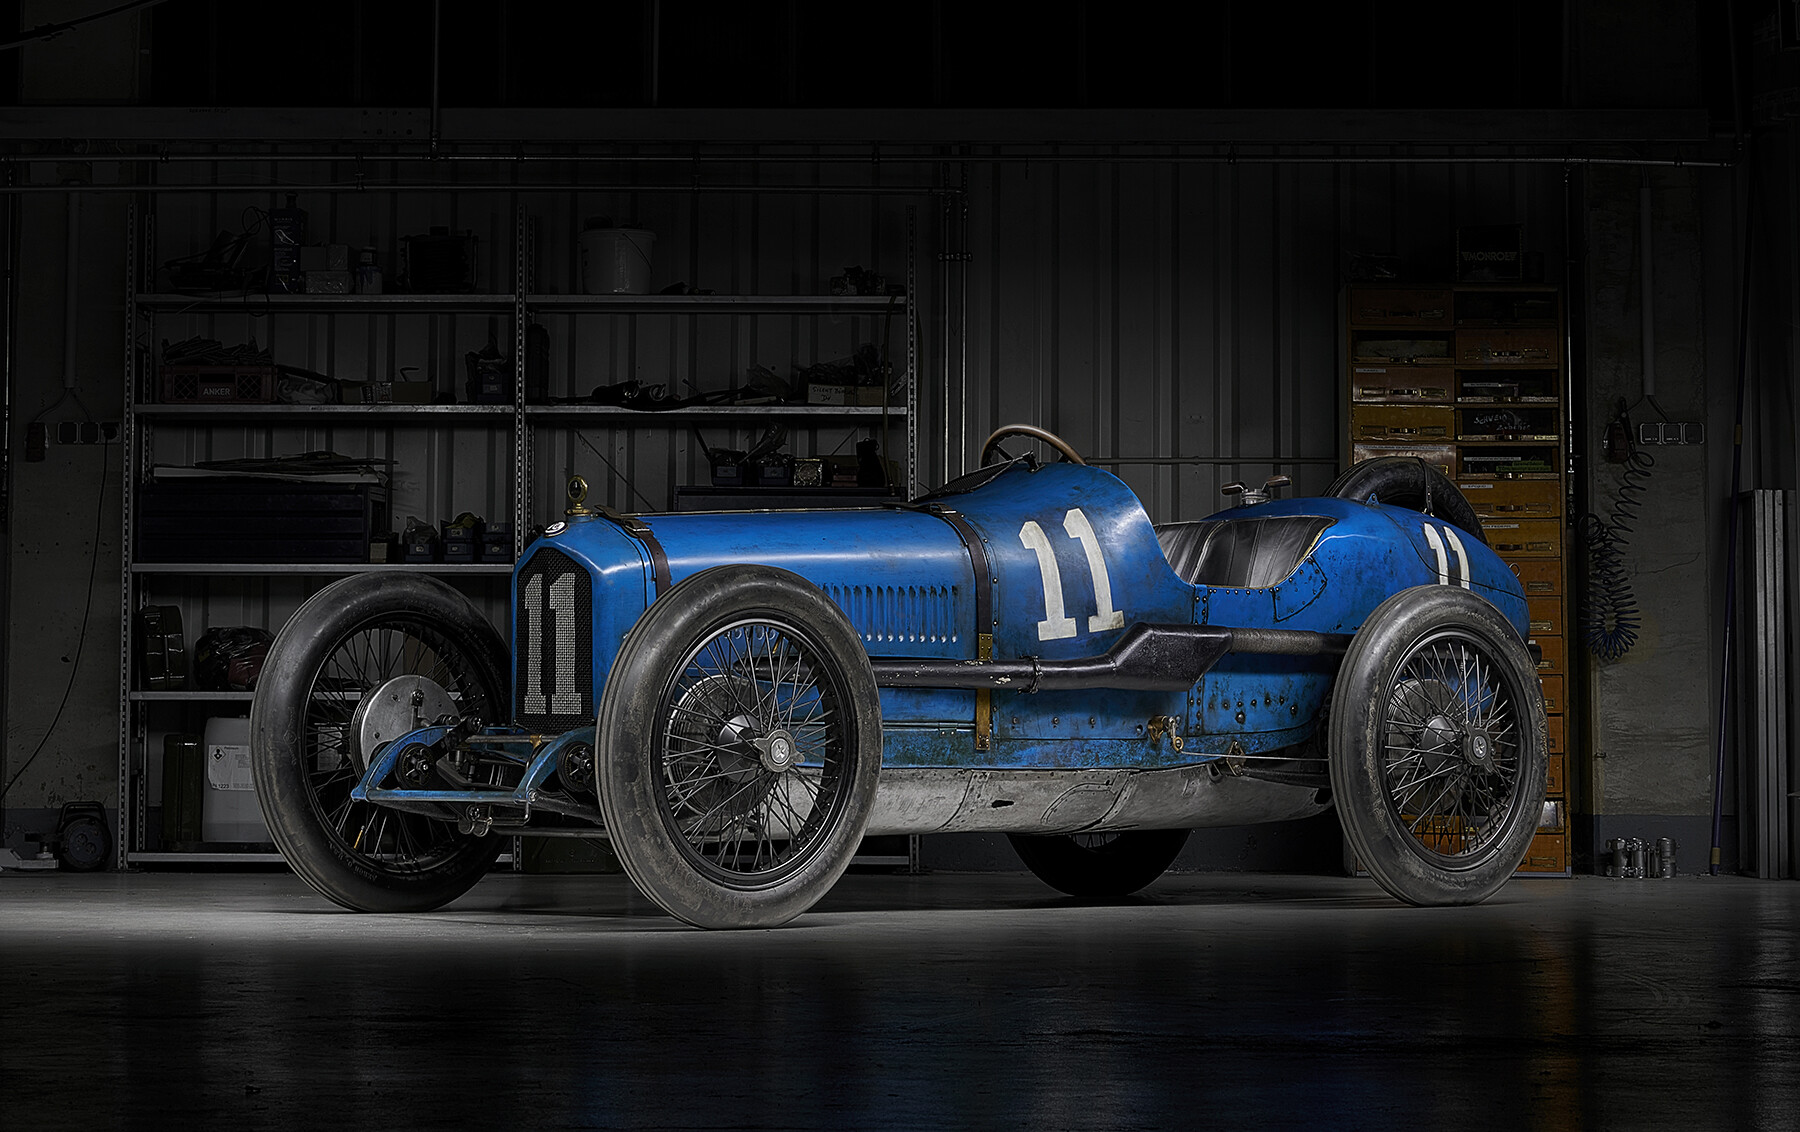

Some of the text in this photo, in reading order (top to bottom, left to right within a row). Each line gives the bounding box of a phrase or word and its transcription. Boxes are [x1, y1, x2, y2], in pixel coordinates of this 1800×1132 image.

[202, 387, 231, 396] ANKER
[1019, 508, 1125, 641] 11
[1424, 522, 1470, 590] 11
[524, 573, 581, 714] 11
